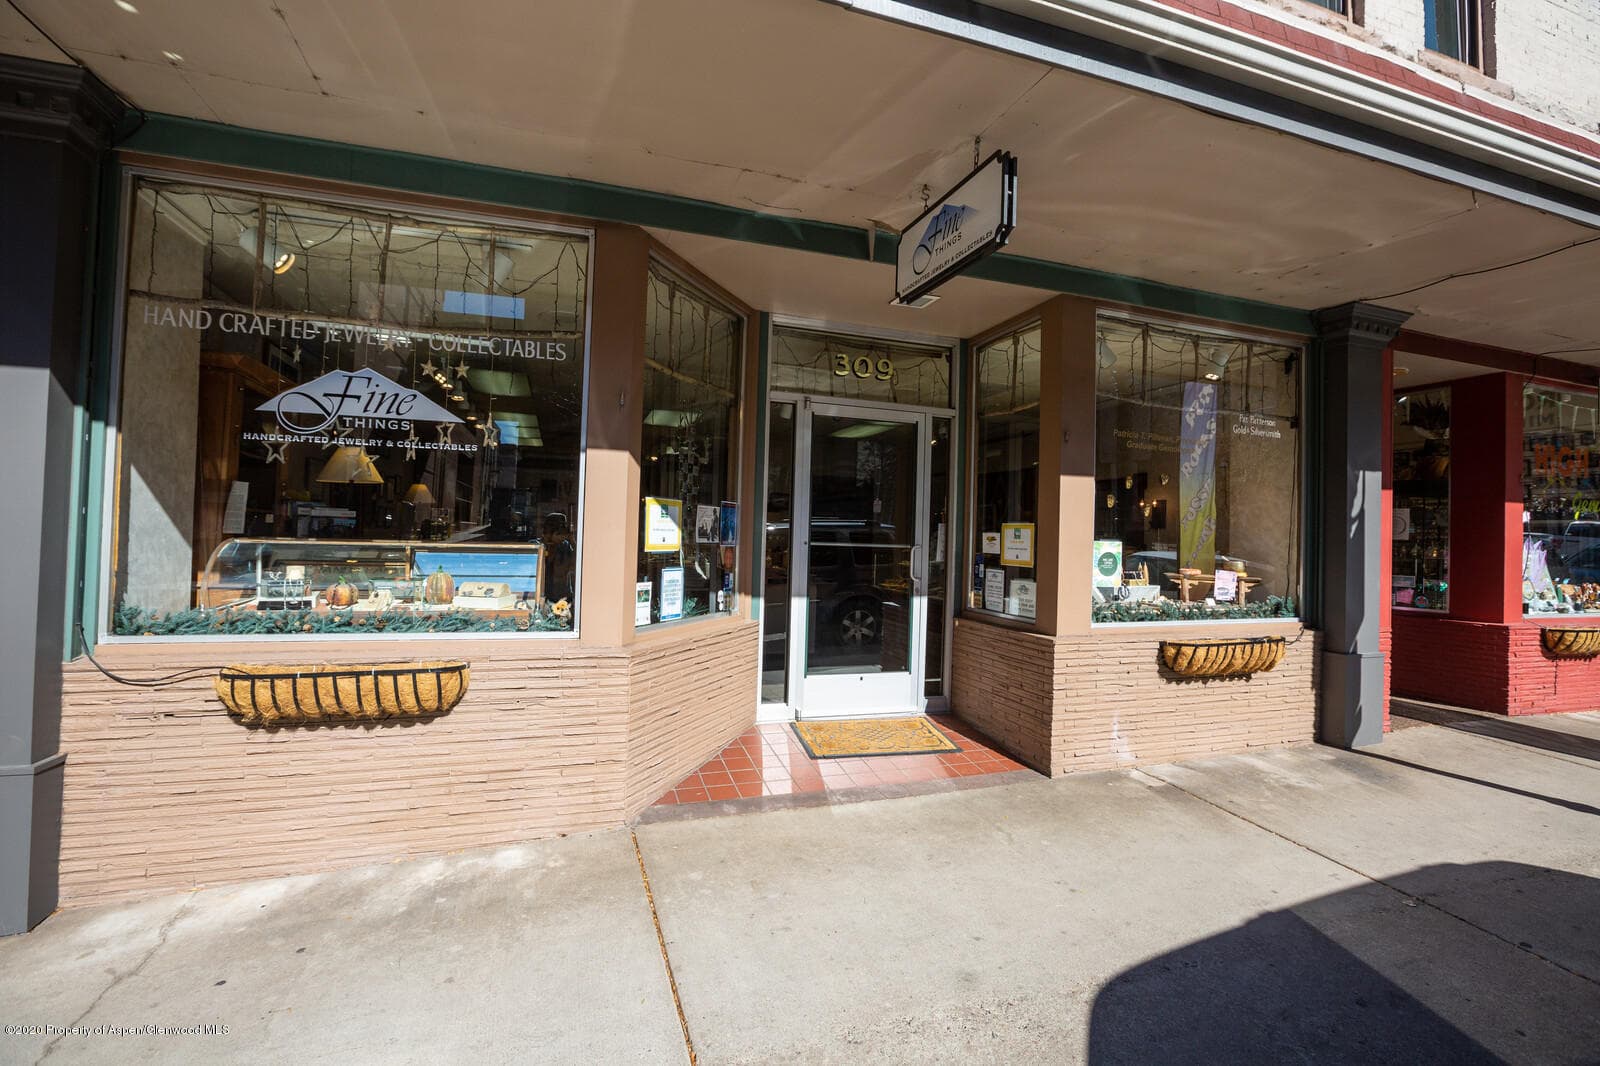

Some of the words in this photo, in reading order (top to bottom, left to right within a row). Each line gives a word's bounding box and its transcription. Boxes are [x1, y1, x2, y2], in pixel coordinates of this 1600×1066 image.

[935, 232, 962, 256] THINGS
[143, 305, 212, 330] HAND
[219, 312, 318, 340] CRAFTED
[324, 324, 412, 348] JEWELRY
[429, 332, 567, 361] COLLECTABLES
[834, 353, 894, 381] 309
[276, 375, 418, 434] Fine
[343, 416, 411, 431] THINGS
[243, 432, 329, 444] HANDCRAFTED
[331, 436, 383, 447] JEWELRY
[397, 440, 478, 452] COLLECTABLES
